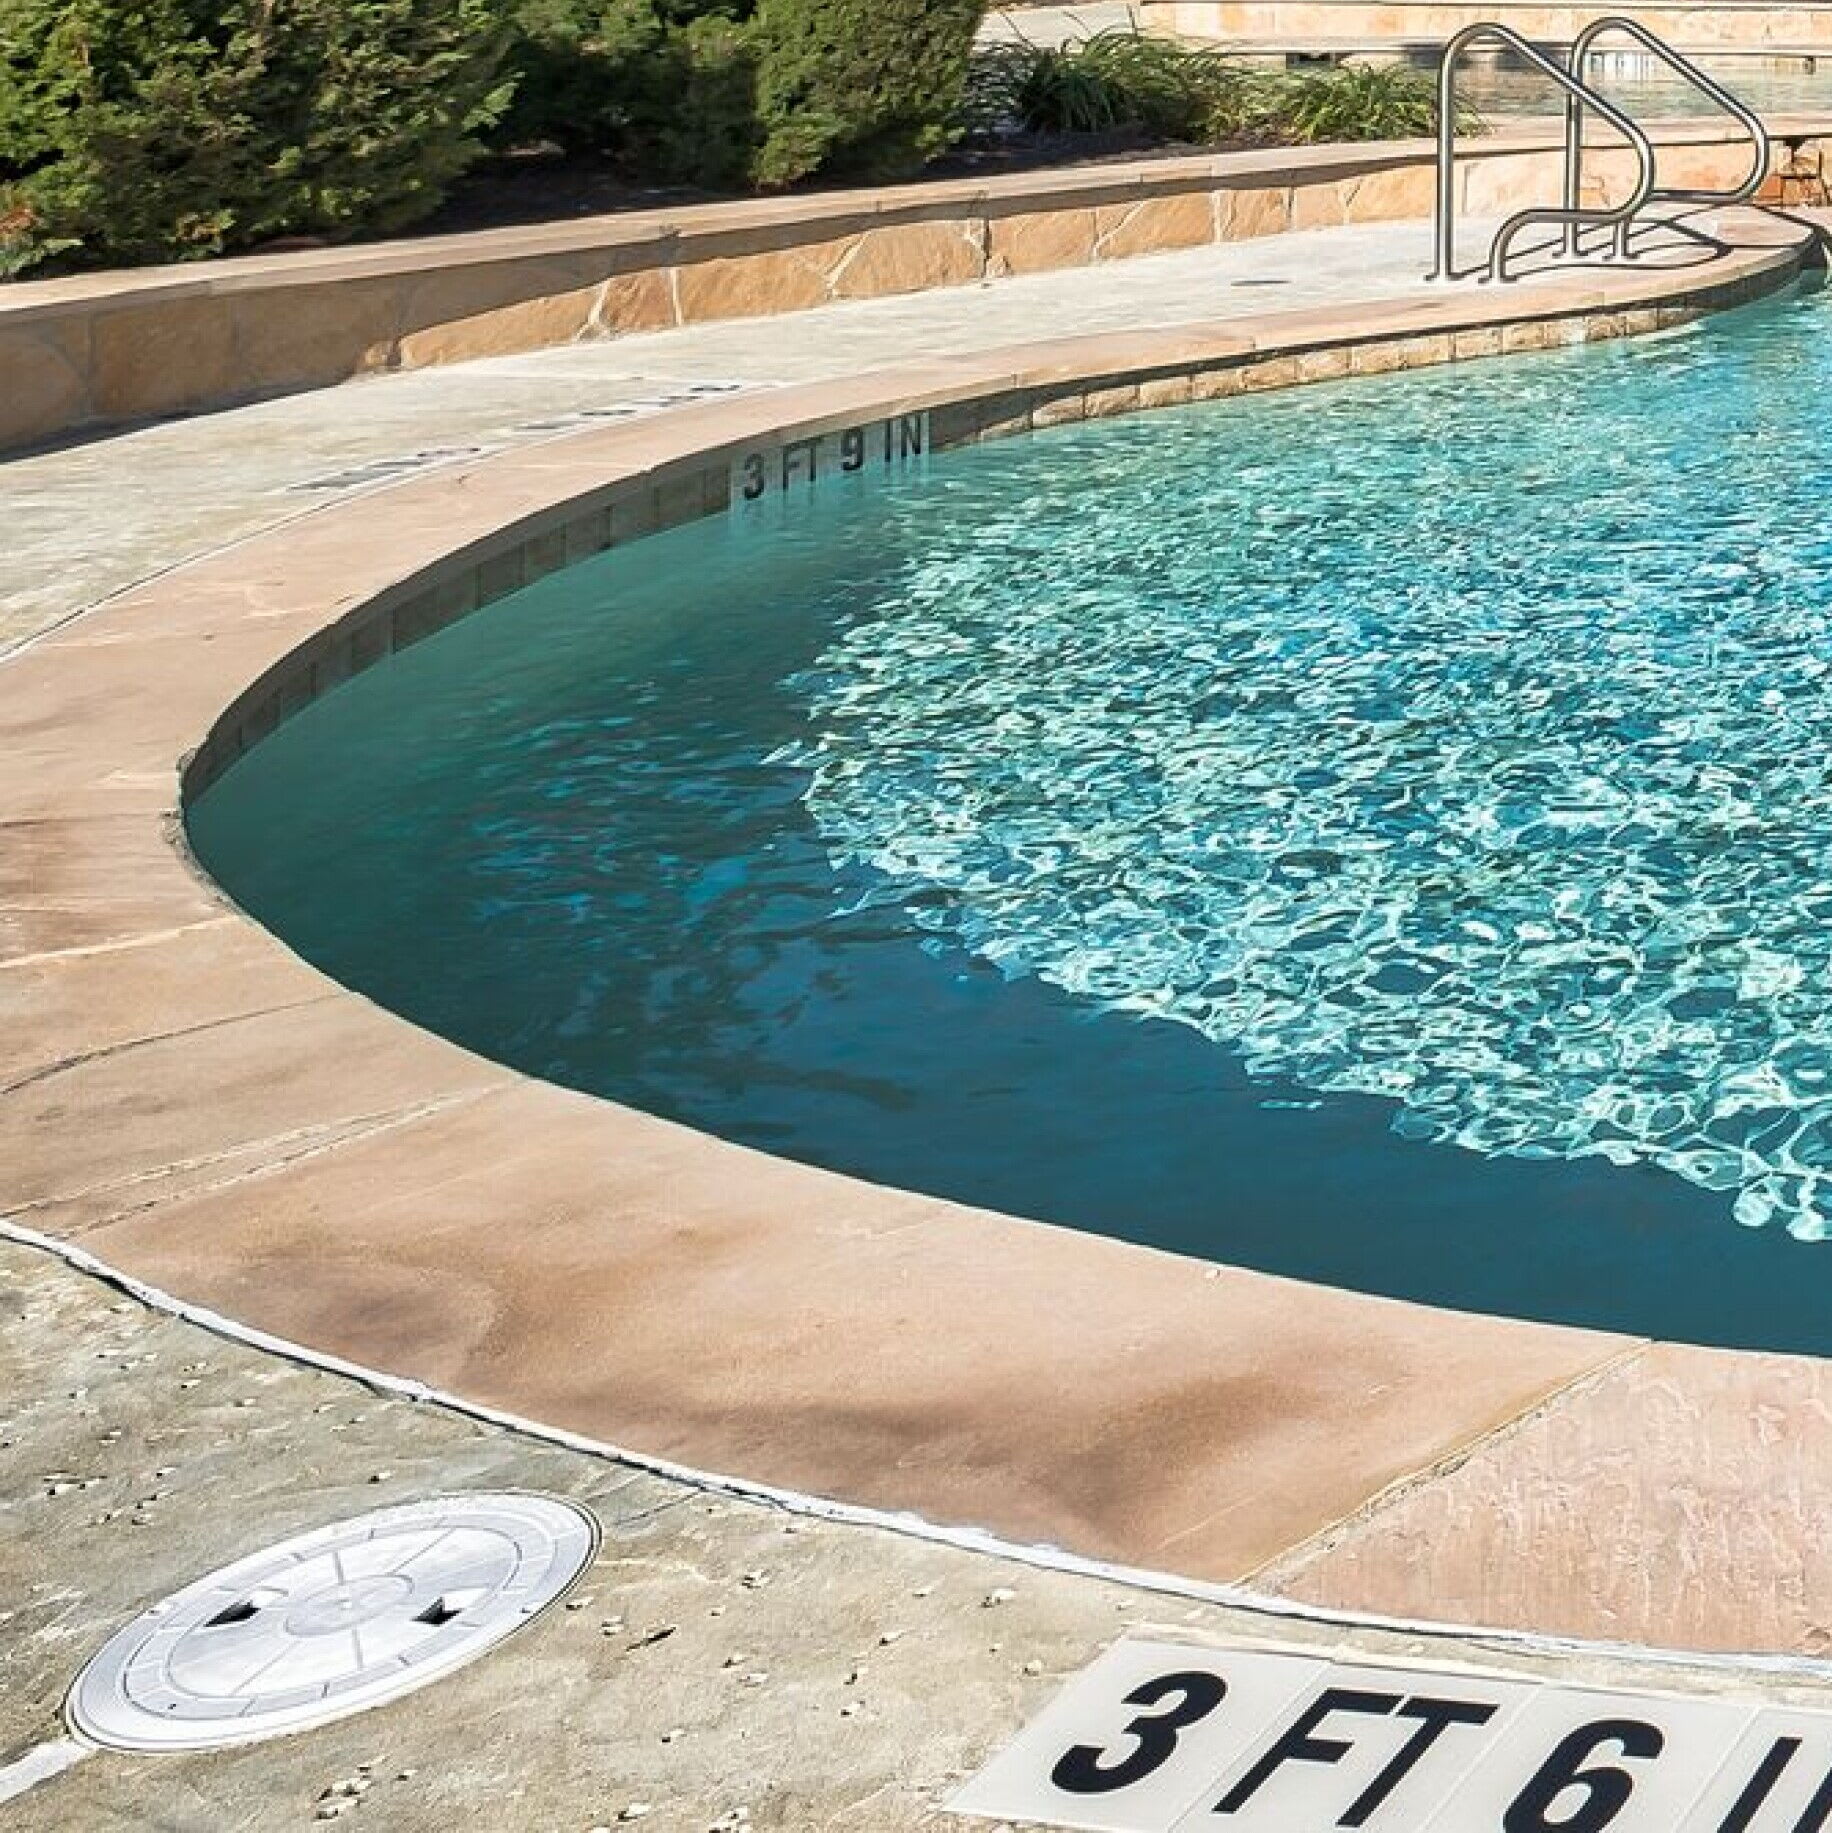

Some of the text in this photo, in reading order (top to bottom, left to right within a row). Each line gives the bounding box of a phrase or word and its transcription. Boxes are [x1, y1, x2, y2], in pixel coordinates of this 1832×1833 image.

[744, 412, 922, 500] 3 FT 9 IN
[1051, 1670, 1228, 1794] 3
[1211, 1687, 1501, 1828] FT
[1502, 1719, 1666, 1833] 6
